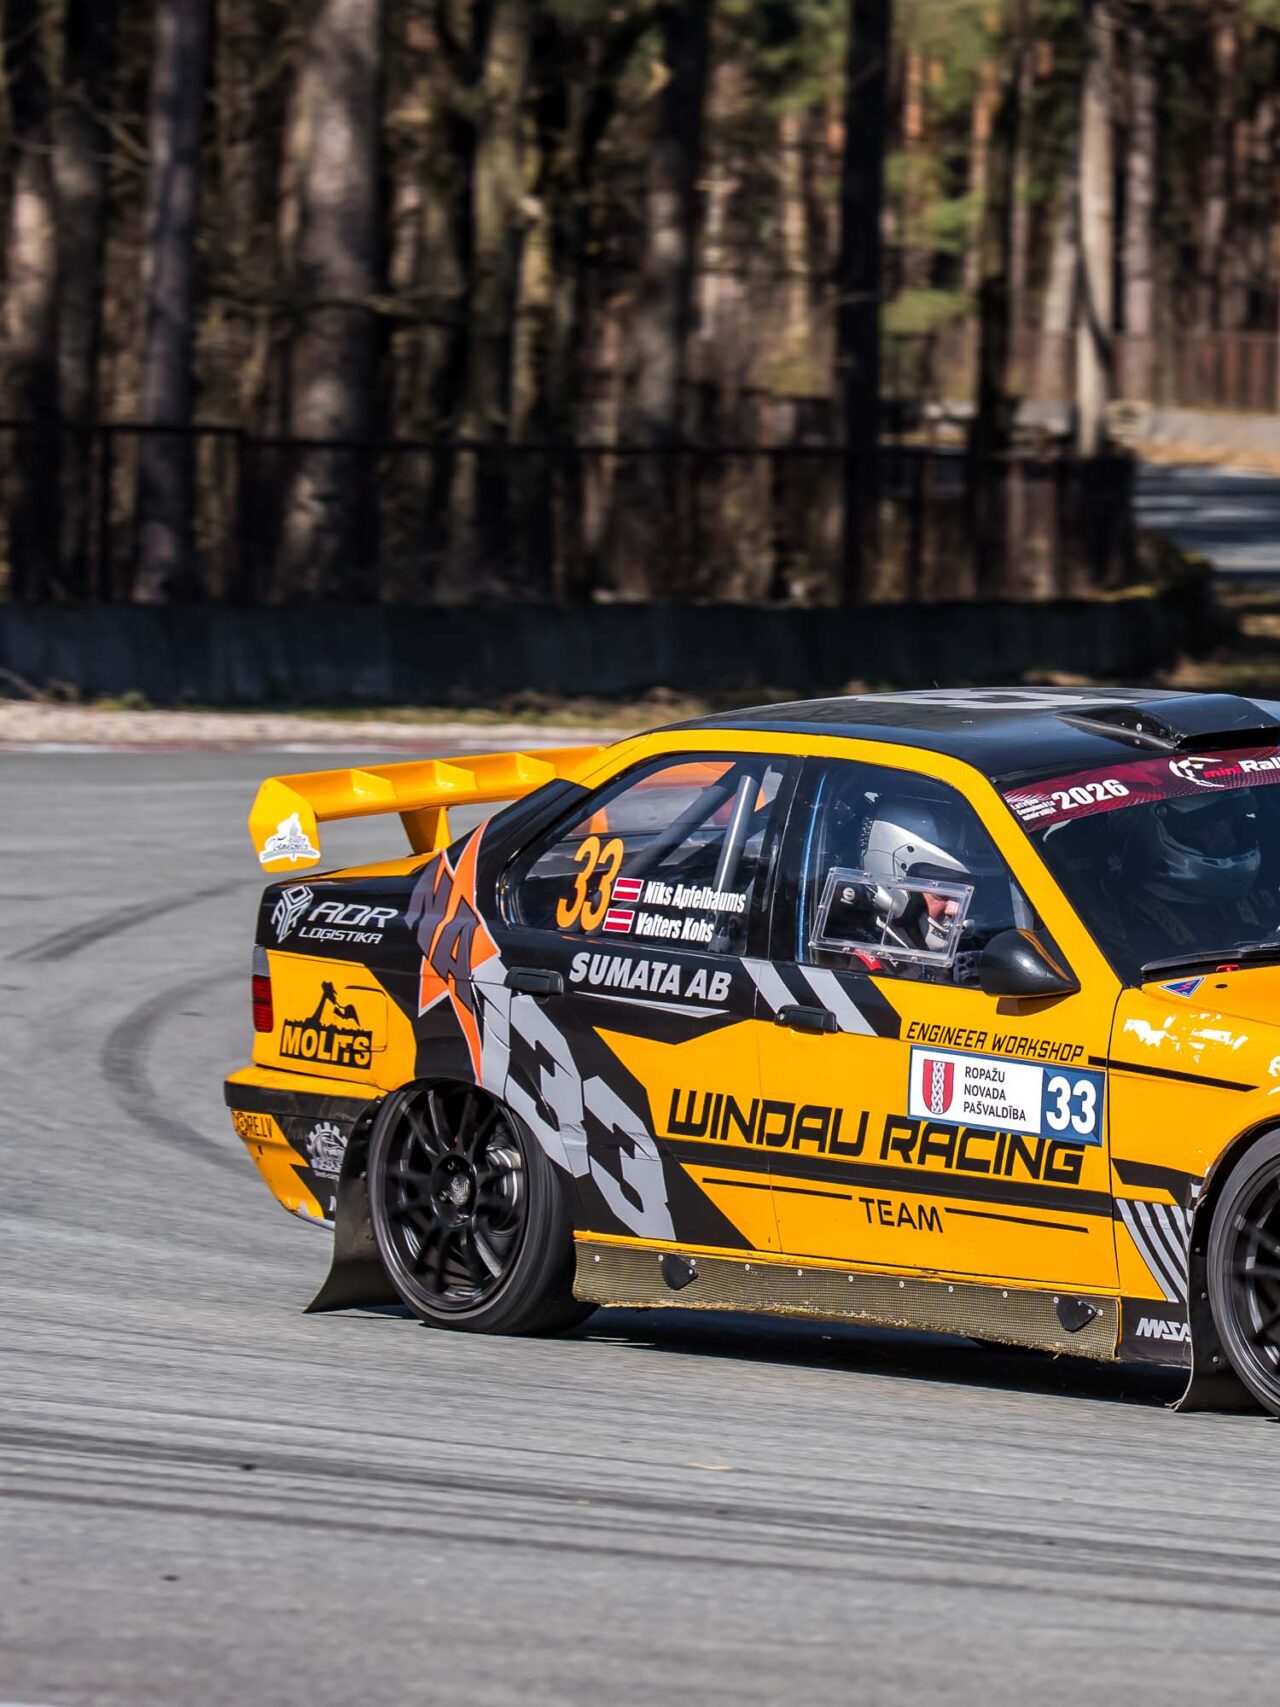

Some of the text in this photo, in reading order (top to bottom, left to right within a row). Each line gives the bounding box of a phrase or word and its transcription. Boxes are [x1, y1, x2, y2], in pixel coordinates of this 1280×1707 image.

[1051, 779, 1130, 810] 2026
[556, 836, 624, 931] 33
[643, 881, 747, 913] Niks Apfelbaums
[308, 901, 399, 928] ADR
[635, 913, 682, 939] Valters
[569, 951, 733, 1001] SUMATA AB
[906, 1021, 1085, 1063] ENGINEER WORKSHOP
[965, 1066, 1006, 1083] ROPAŽU
[964, 1083, 1007, 1101] NOVADA
[1046, 1075, 1097, 1135] 33
[963, 1101, 1027, 1122] PAŠVALDĪBA
[667, 1088, 1087, 1185] WINDAU RACING
[858, 1196, 944, 1234] TEAM
